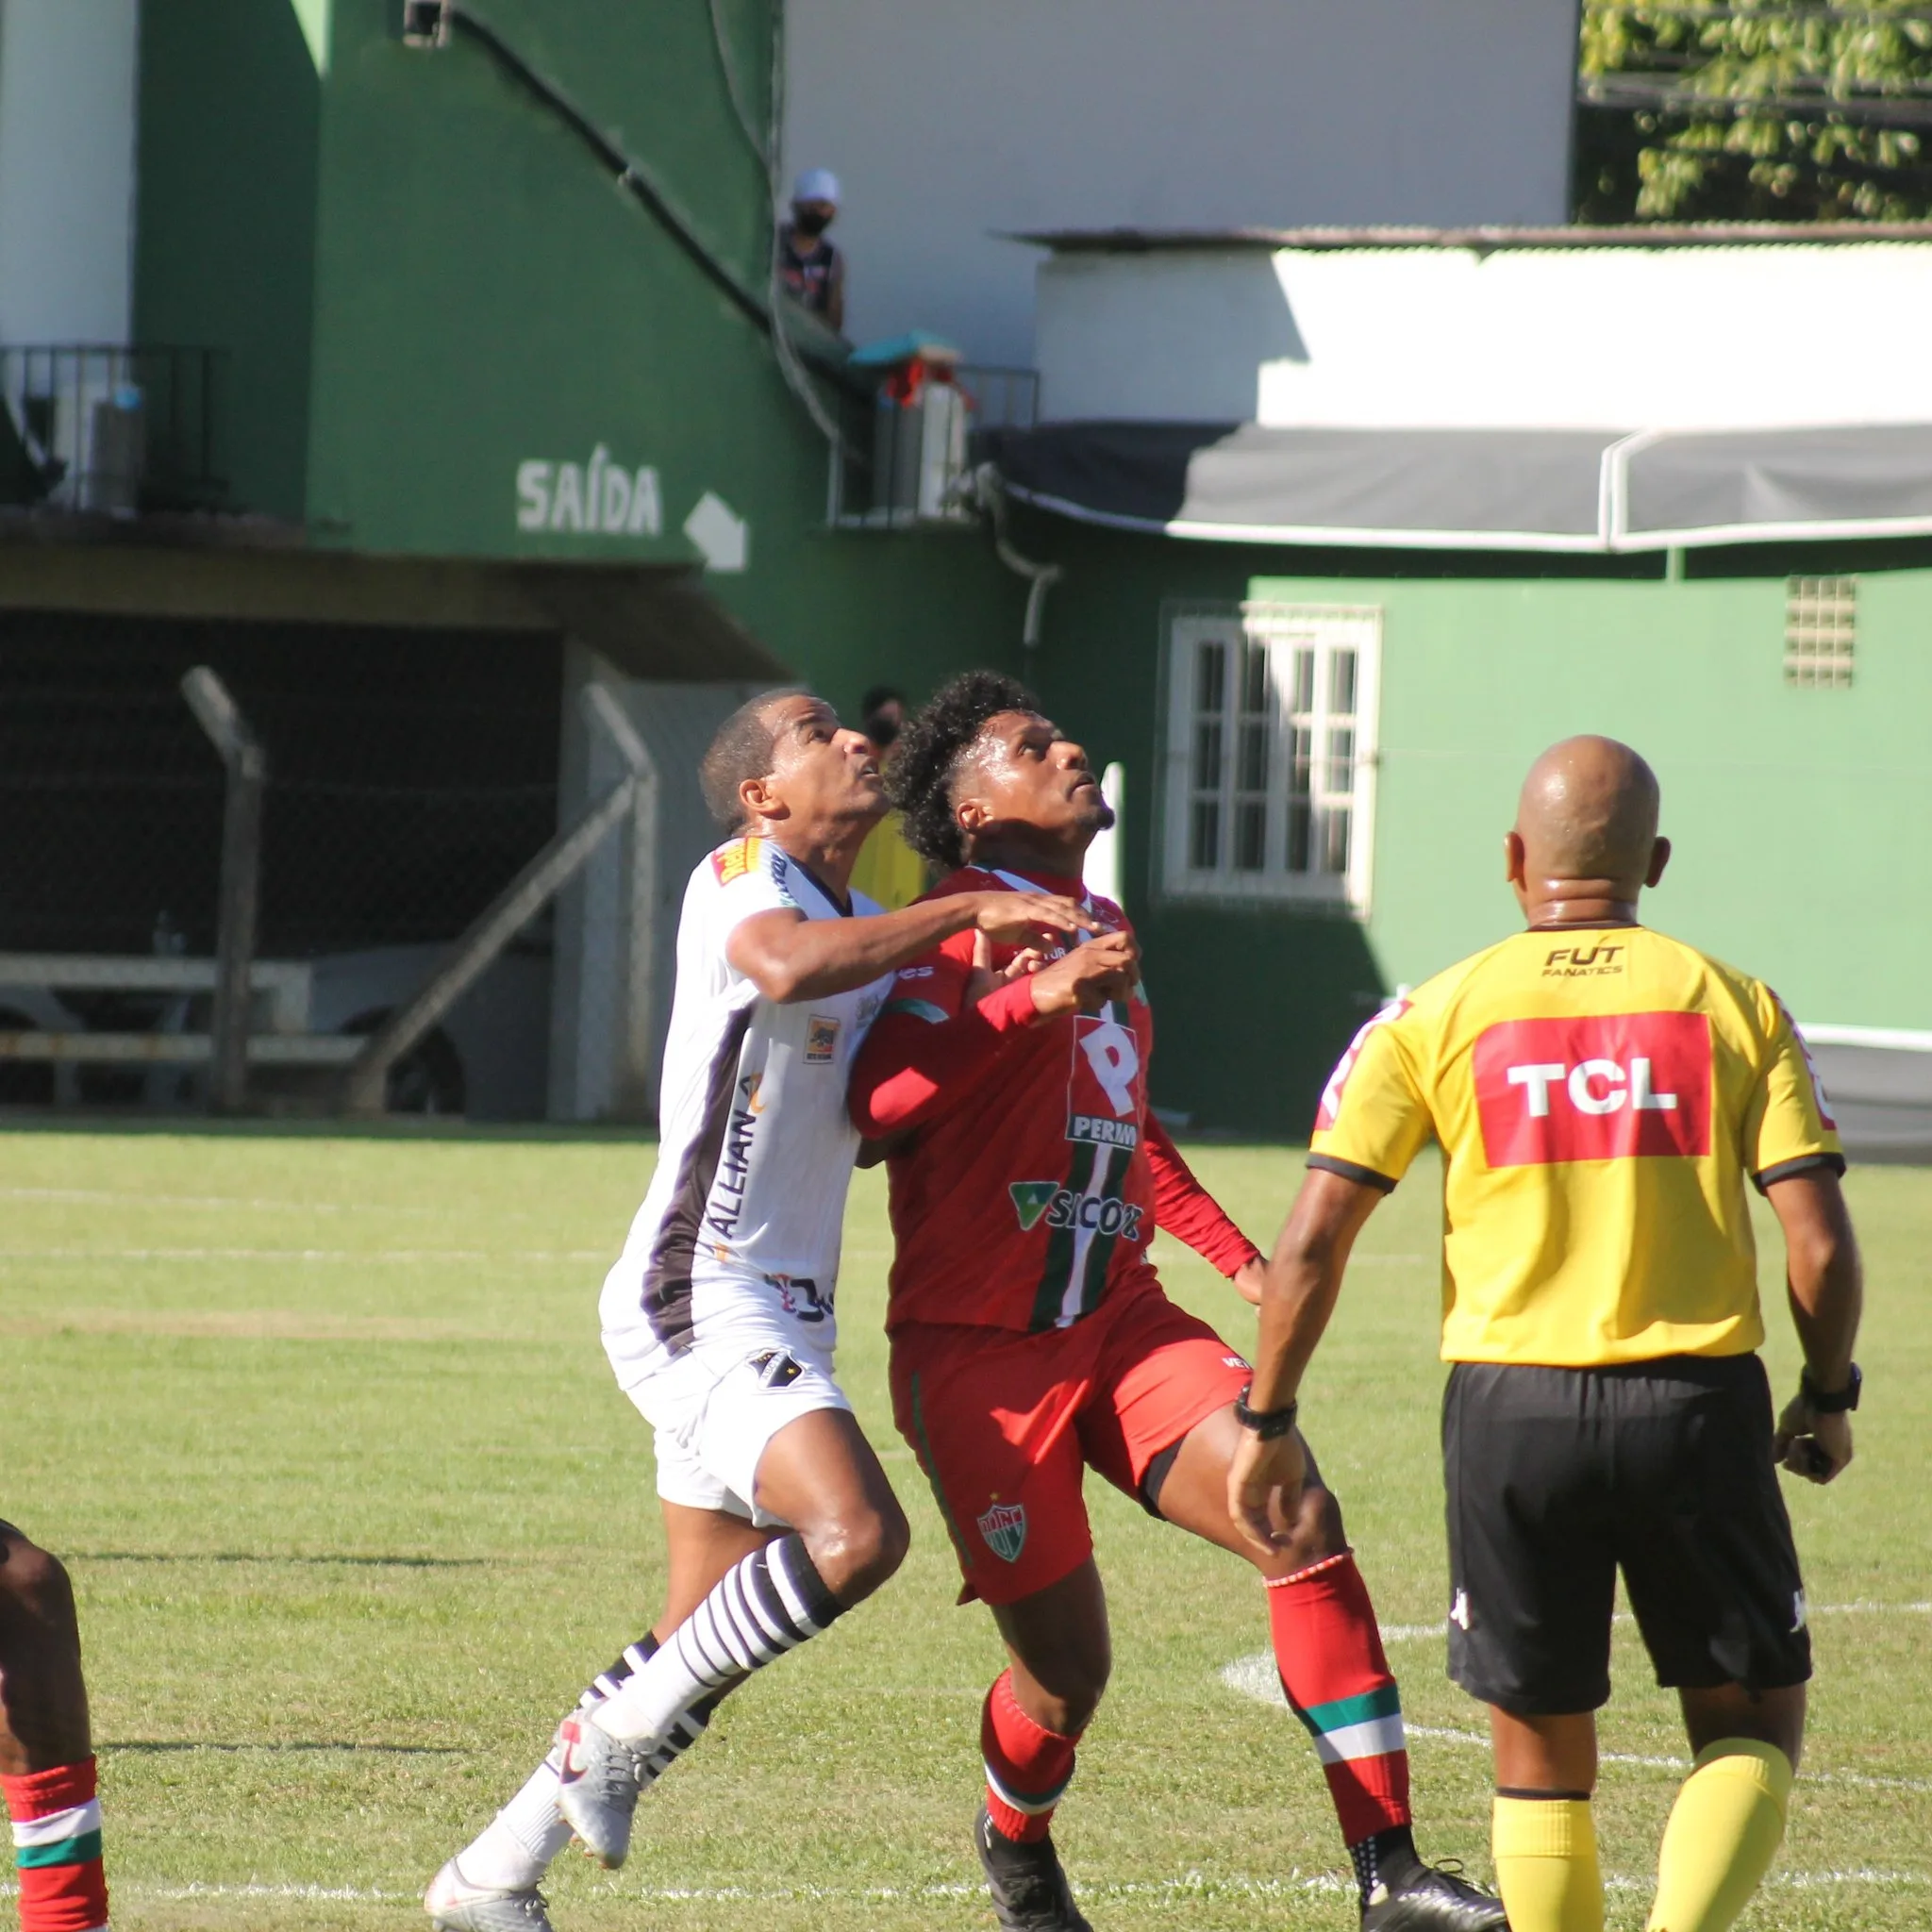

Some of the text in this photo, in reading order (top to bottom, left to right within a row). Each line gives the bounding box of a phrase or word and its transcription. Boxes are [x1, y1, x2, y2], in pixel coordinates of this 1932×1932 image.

[516, 441, 662, 537] SAÍDA
[1541, 965, 1623, 977] FANATICS
[1544, 945, 1624, 967] FUT
[1507, 1057, 1677, 1117] TCL
